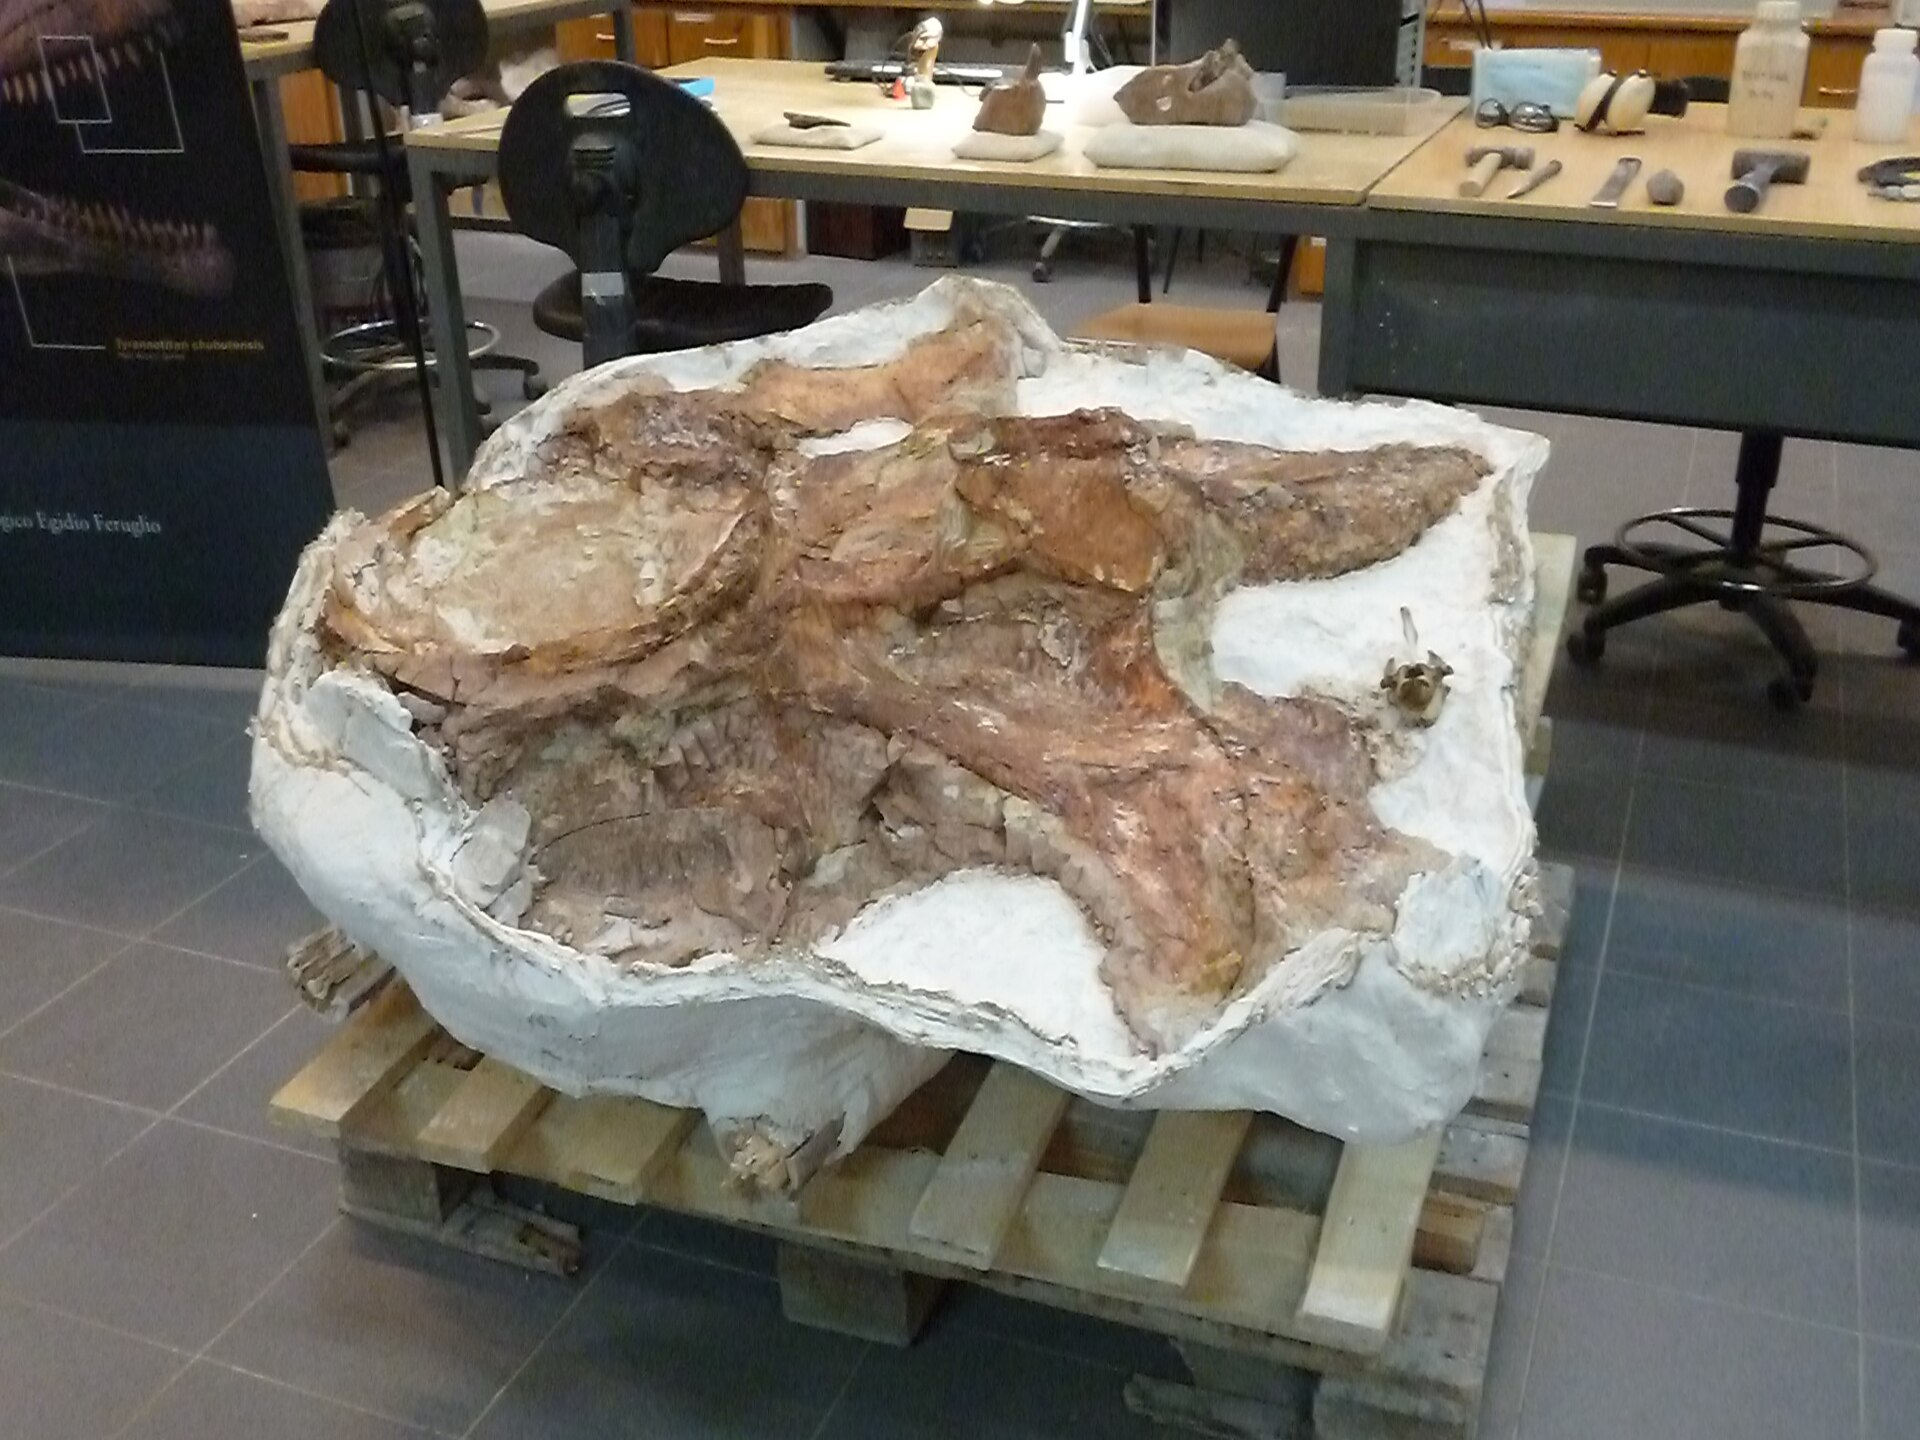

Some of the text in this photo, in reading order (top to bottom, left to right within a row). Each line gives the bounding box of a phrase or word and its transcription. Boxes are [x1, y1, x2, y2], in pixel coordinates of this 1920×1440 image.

[192, 339, 265, 351] chubutensis
[36, 510, 90, 534] Egidio
[93, 513, 162, 538] Feruglio
